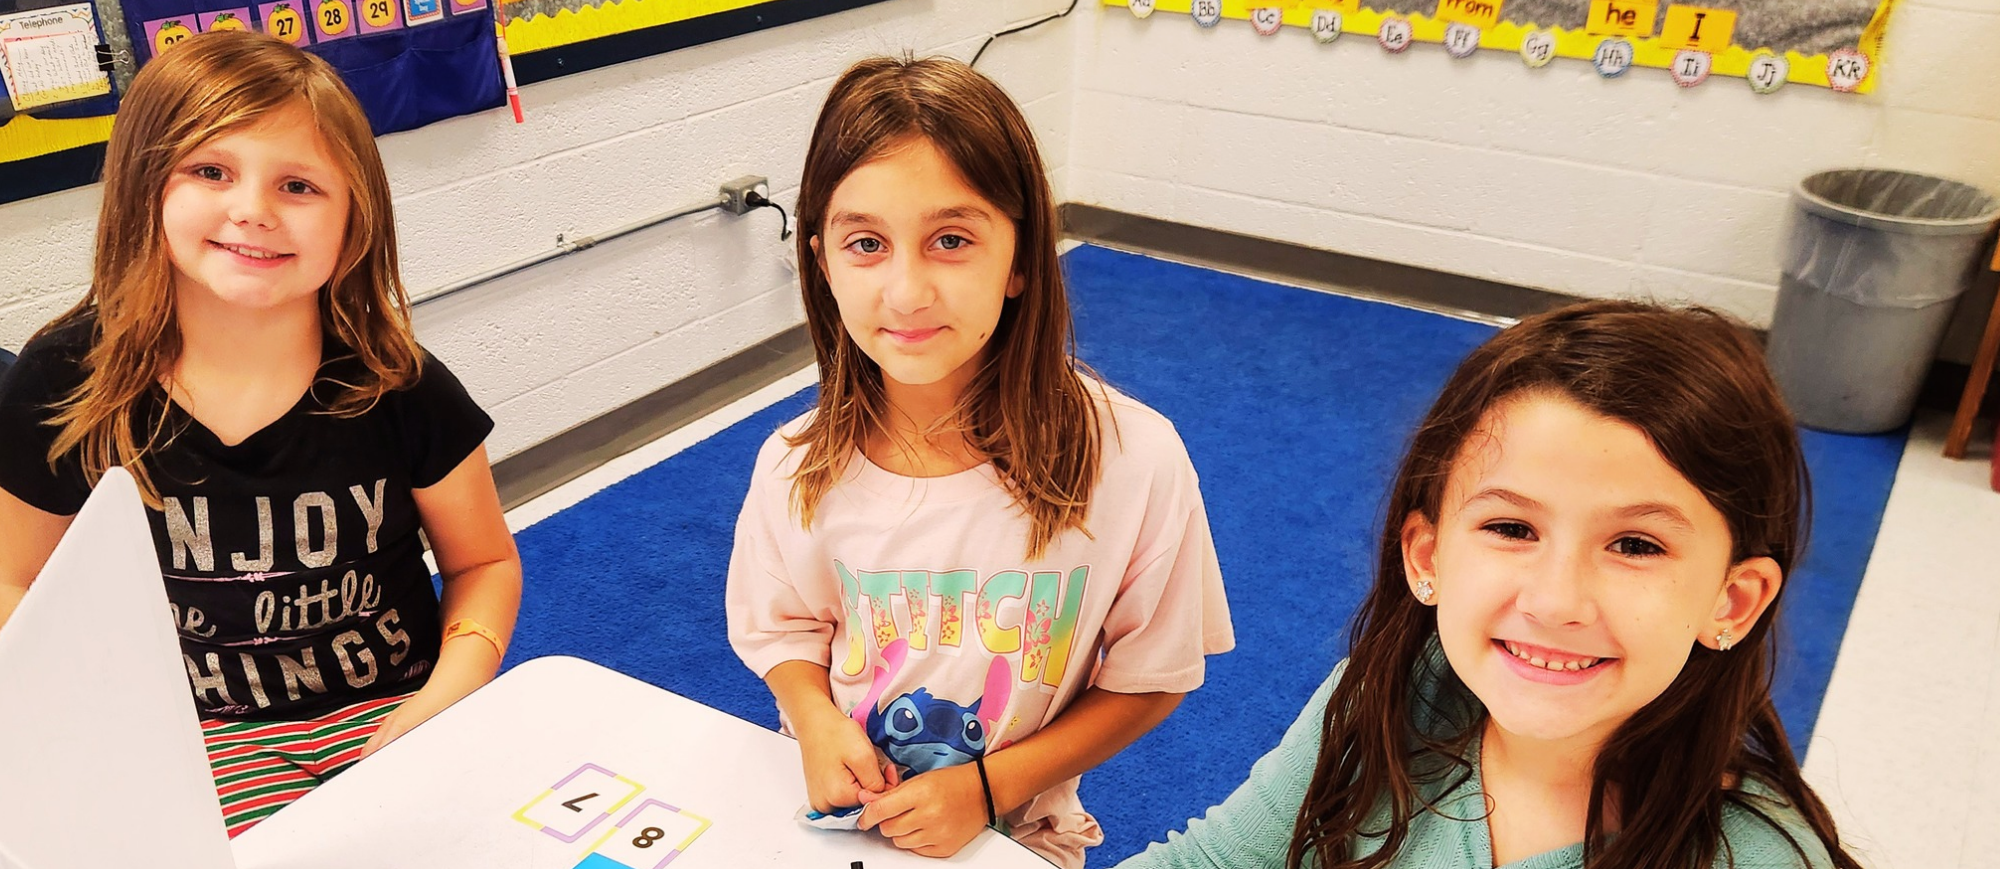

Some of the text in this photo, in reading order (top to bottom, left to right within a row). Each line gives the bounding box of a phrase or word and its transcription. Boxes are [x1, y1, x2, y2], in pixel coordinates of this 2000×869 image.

[324, 8, 342, 26] 28
[369, 1, 389, 18] 29
[1198, 1, 1216, 17] Bb
[1256, 7, 1275, 24] Cc
[1605, 3, 1637, 26] he
[19, 15, 64, 30] Telephone
[276, 17, 294, 36] 27
[1317, 15, 1336, 32] Dd
[1385, 25, 1403, 44] Ee
[1453, 29, 1472, 48] Ff
[1525, 36, 1551, 61] Gg
[1600, 47, 1625, 68] Hh
[1680, 58, 1700, 77] Ii
[1757, 63, 1777, 88] Jj
[162, 477, 388, 573] NJOY
[254, 569, 382, 634] little
[833, 558, 1092, 690] STITCH
[183, 608, 411, 709] HINGS
[561, 792, 600, 813] 7
[632, 826, 665, 849] 8
